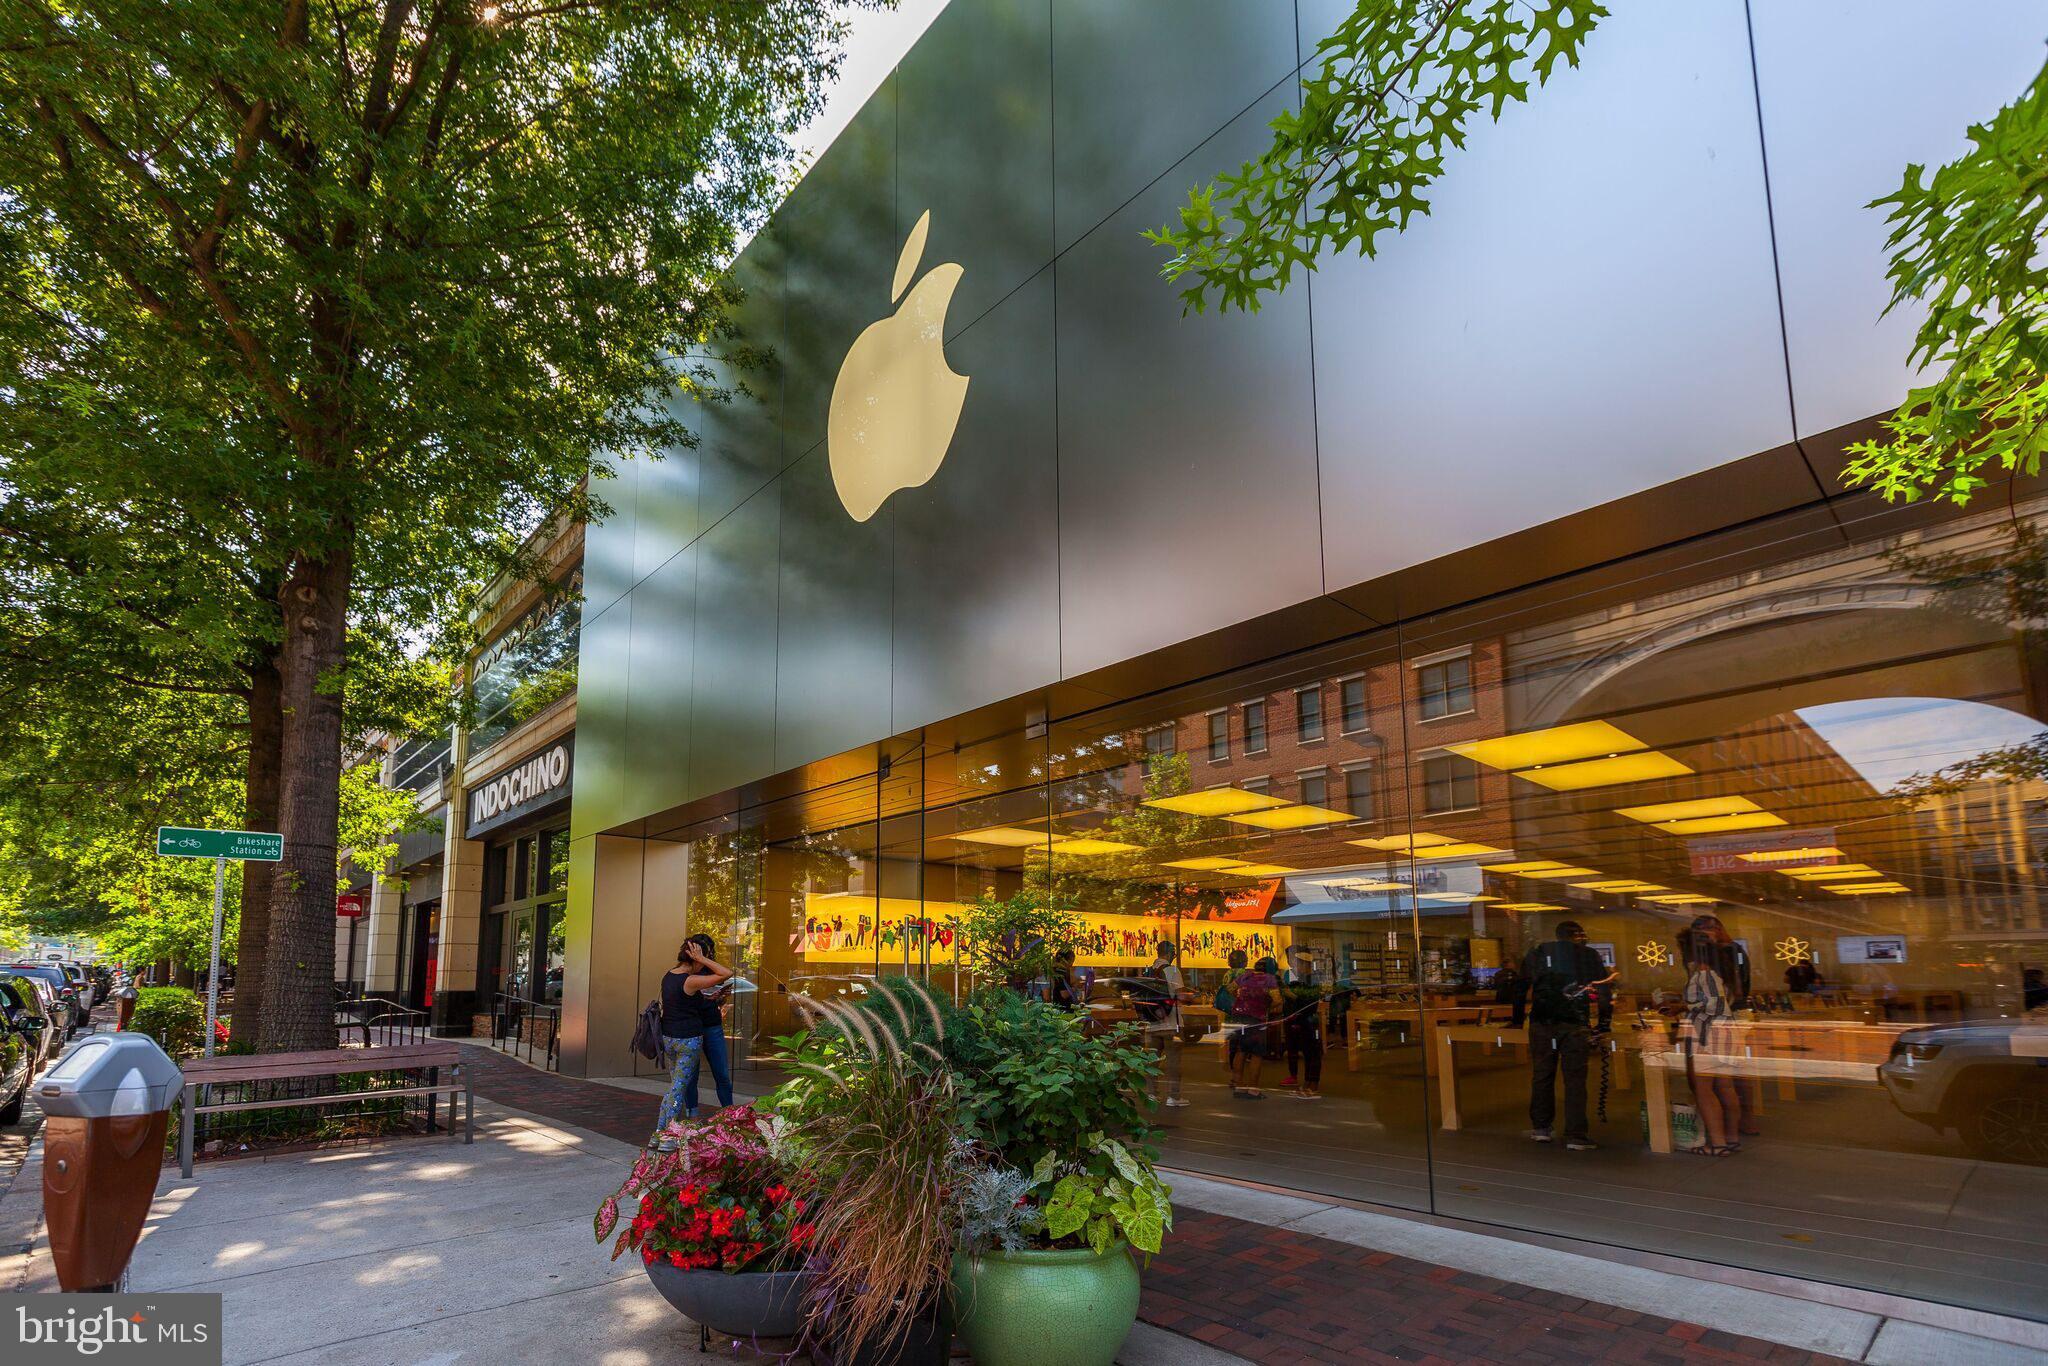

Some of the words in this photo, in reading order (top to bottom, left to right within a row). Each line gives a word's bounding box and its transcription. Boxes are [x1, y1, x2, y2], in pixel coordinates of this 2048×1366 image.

[474, 745, 567, 823] INDOCHINO
[237, 837, 280, 847] Bikeshare
[230, 846, 262, 855] Station
